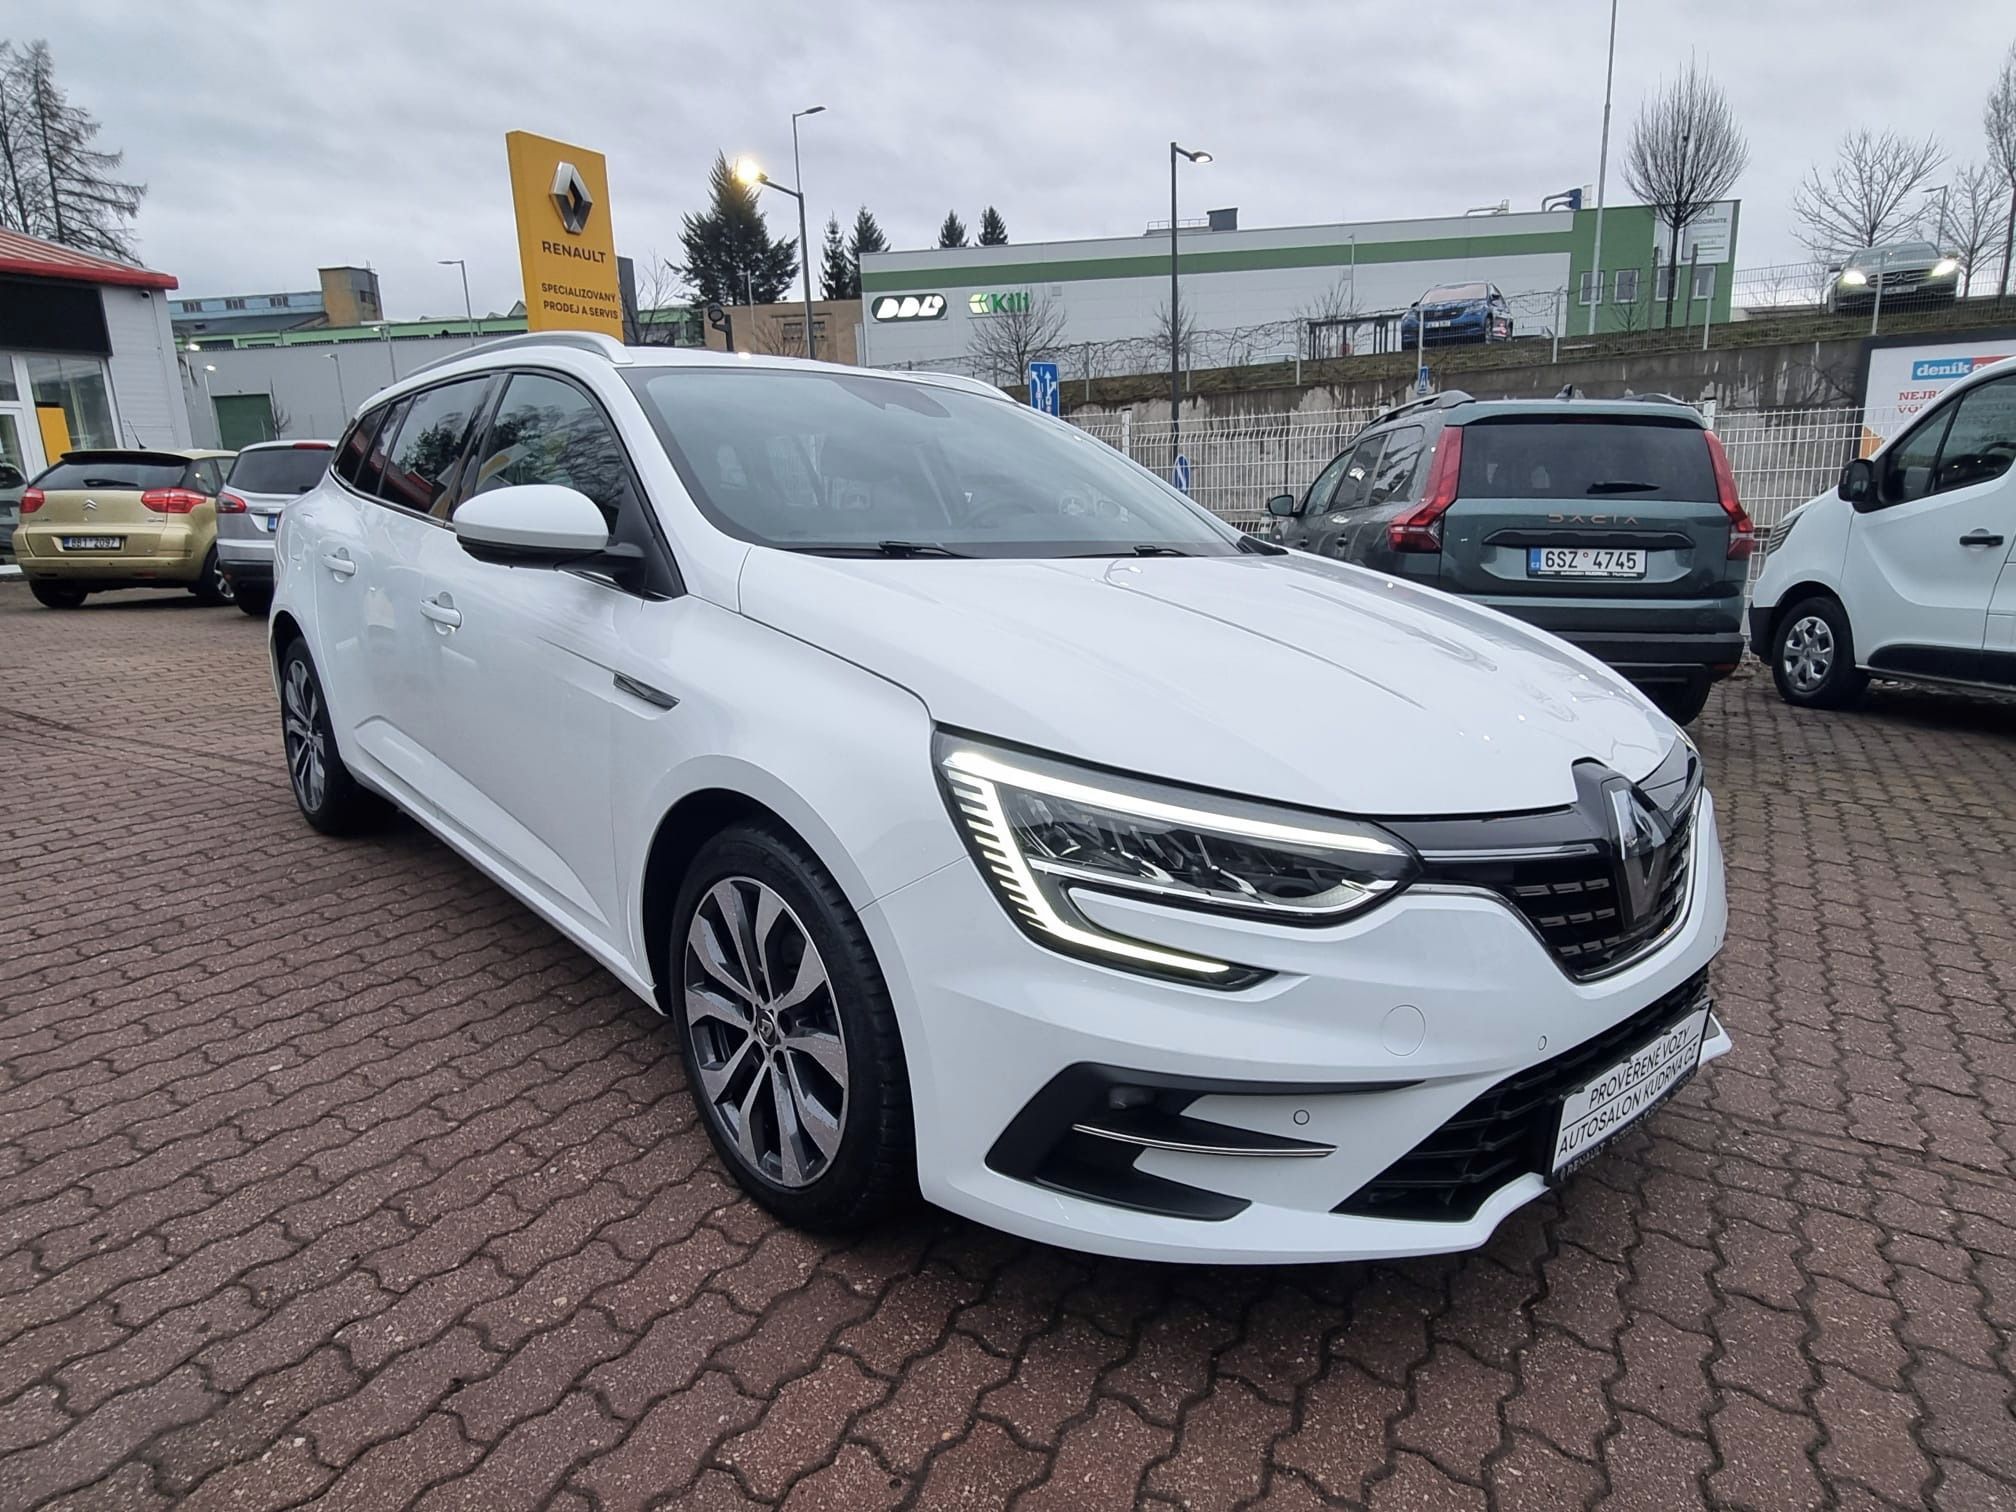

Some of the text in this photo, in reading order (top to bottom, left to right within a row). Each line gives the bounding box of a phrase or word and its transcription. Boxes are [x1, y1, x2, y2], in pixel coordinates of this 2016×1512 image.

[541, 240, 606, 264] RENAULT
[543, 299, 619, 320] PRODEJ A SERVIS
[1916, 361, 1970, 377] deník
[1898, 389, 1944, 401] NEJR
[1547, 513, 1639, 525] DACIA
[1545, 550, 1578, 569] 6SZ
[1592, 551, 1638, 570] 4745
[1663, 1025, 1691, 1059] VOZY
[1557, 1088, 1642, 1158] AUTOSALON
[1642, 1056, 1683, 1102] KUDRNA
[1684, 1041, 1698, 1065] CZ
